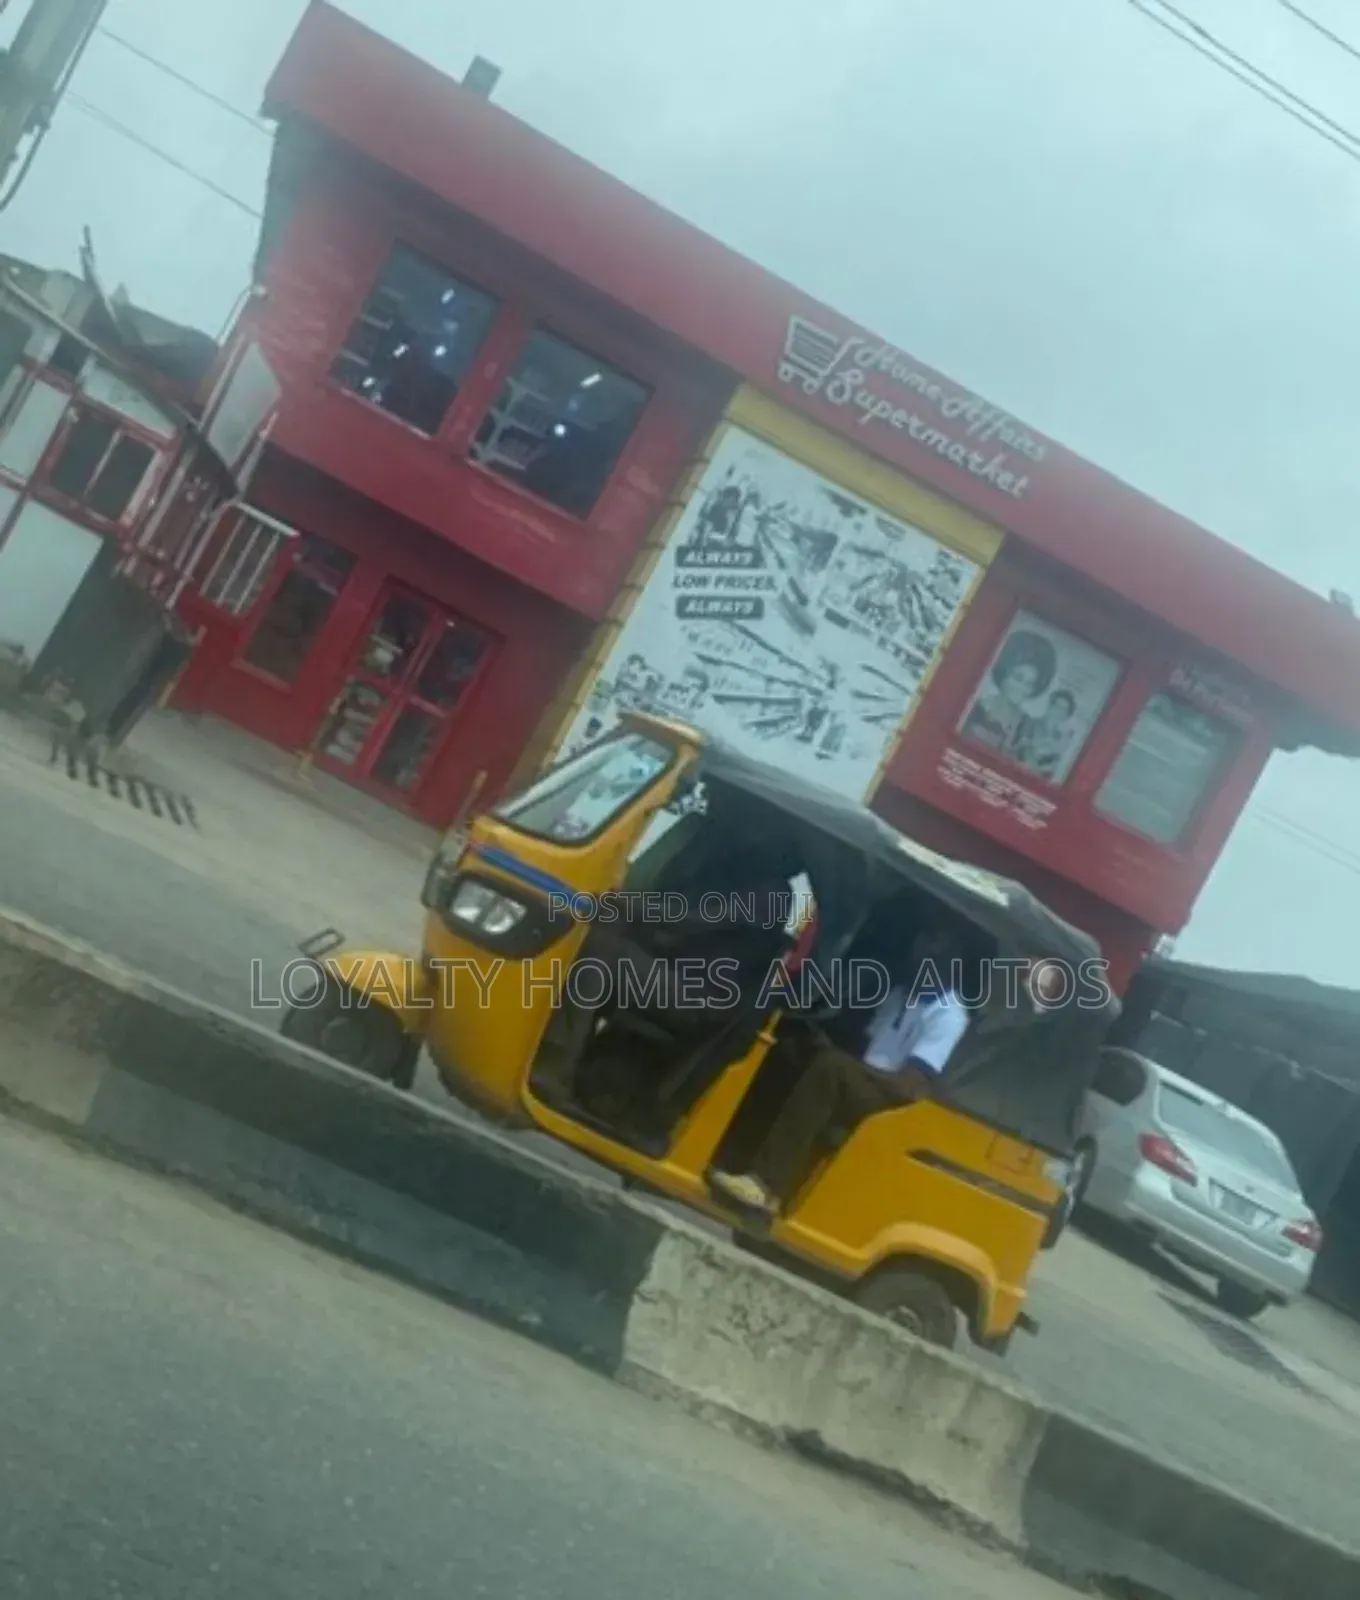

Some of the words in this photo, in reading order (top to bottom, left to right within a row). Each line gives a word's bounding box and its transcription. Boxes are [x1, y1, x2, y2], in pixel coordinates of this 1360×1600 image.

[826, 367, 1029, 498] Supermarket
[683, 551, 754, 566] ALWAYS
[673, 574, 709, 589] LOW
[684, 599, 755, 614] ALWAYS
